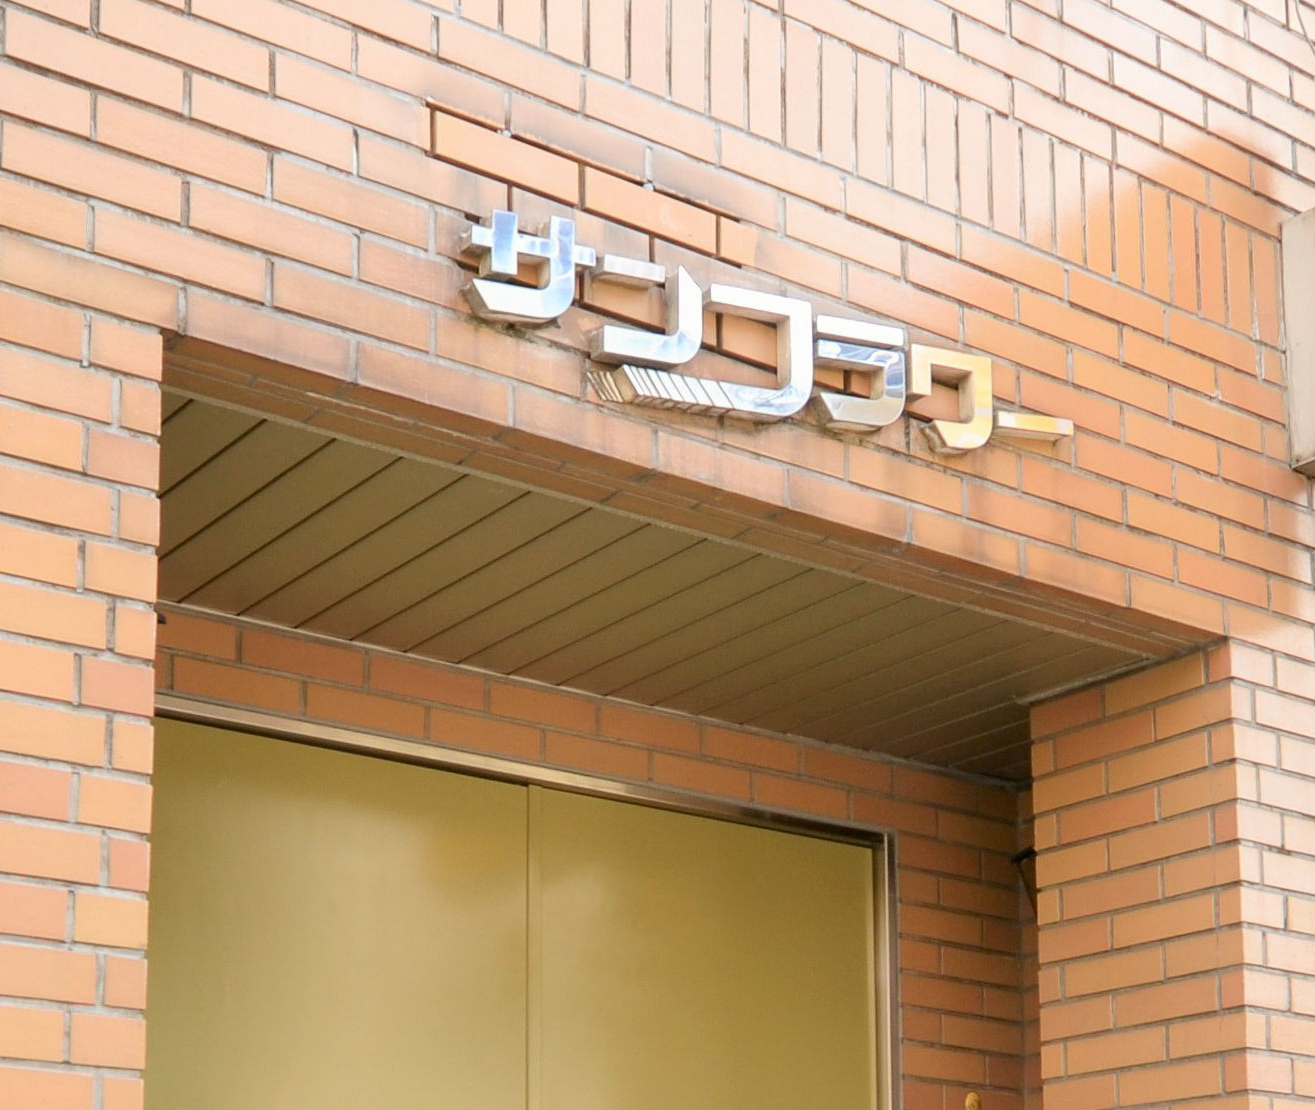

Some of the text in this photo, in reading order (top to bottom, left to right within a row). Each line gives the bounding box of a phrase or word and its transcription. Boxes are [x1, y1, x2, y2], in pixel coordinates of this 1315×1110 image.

[459, 209, 1074, 455] サンフラワー
